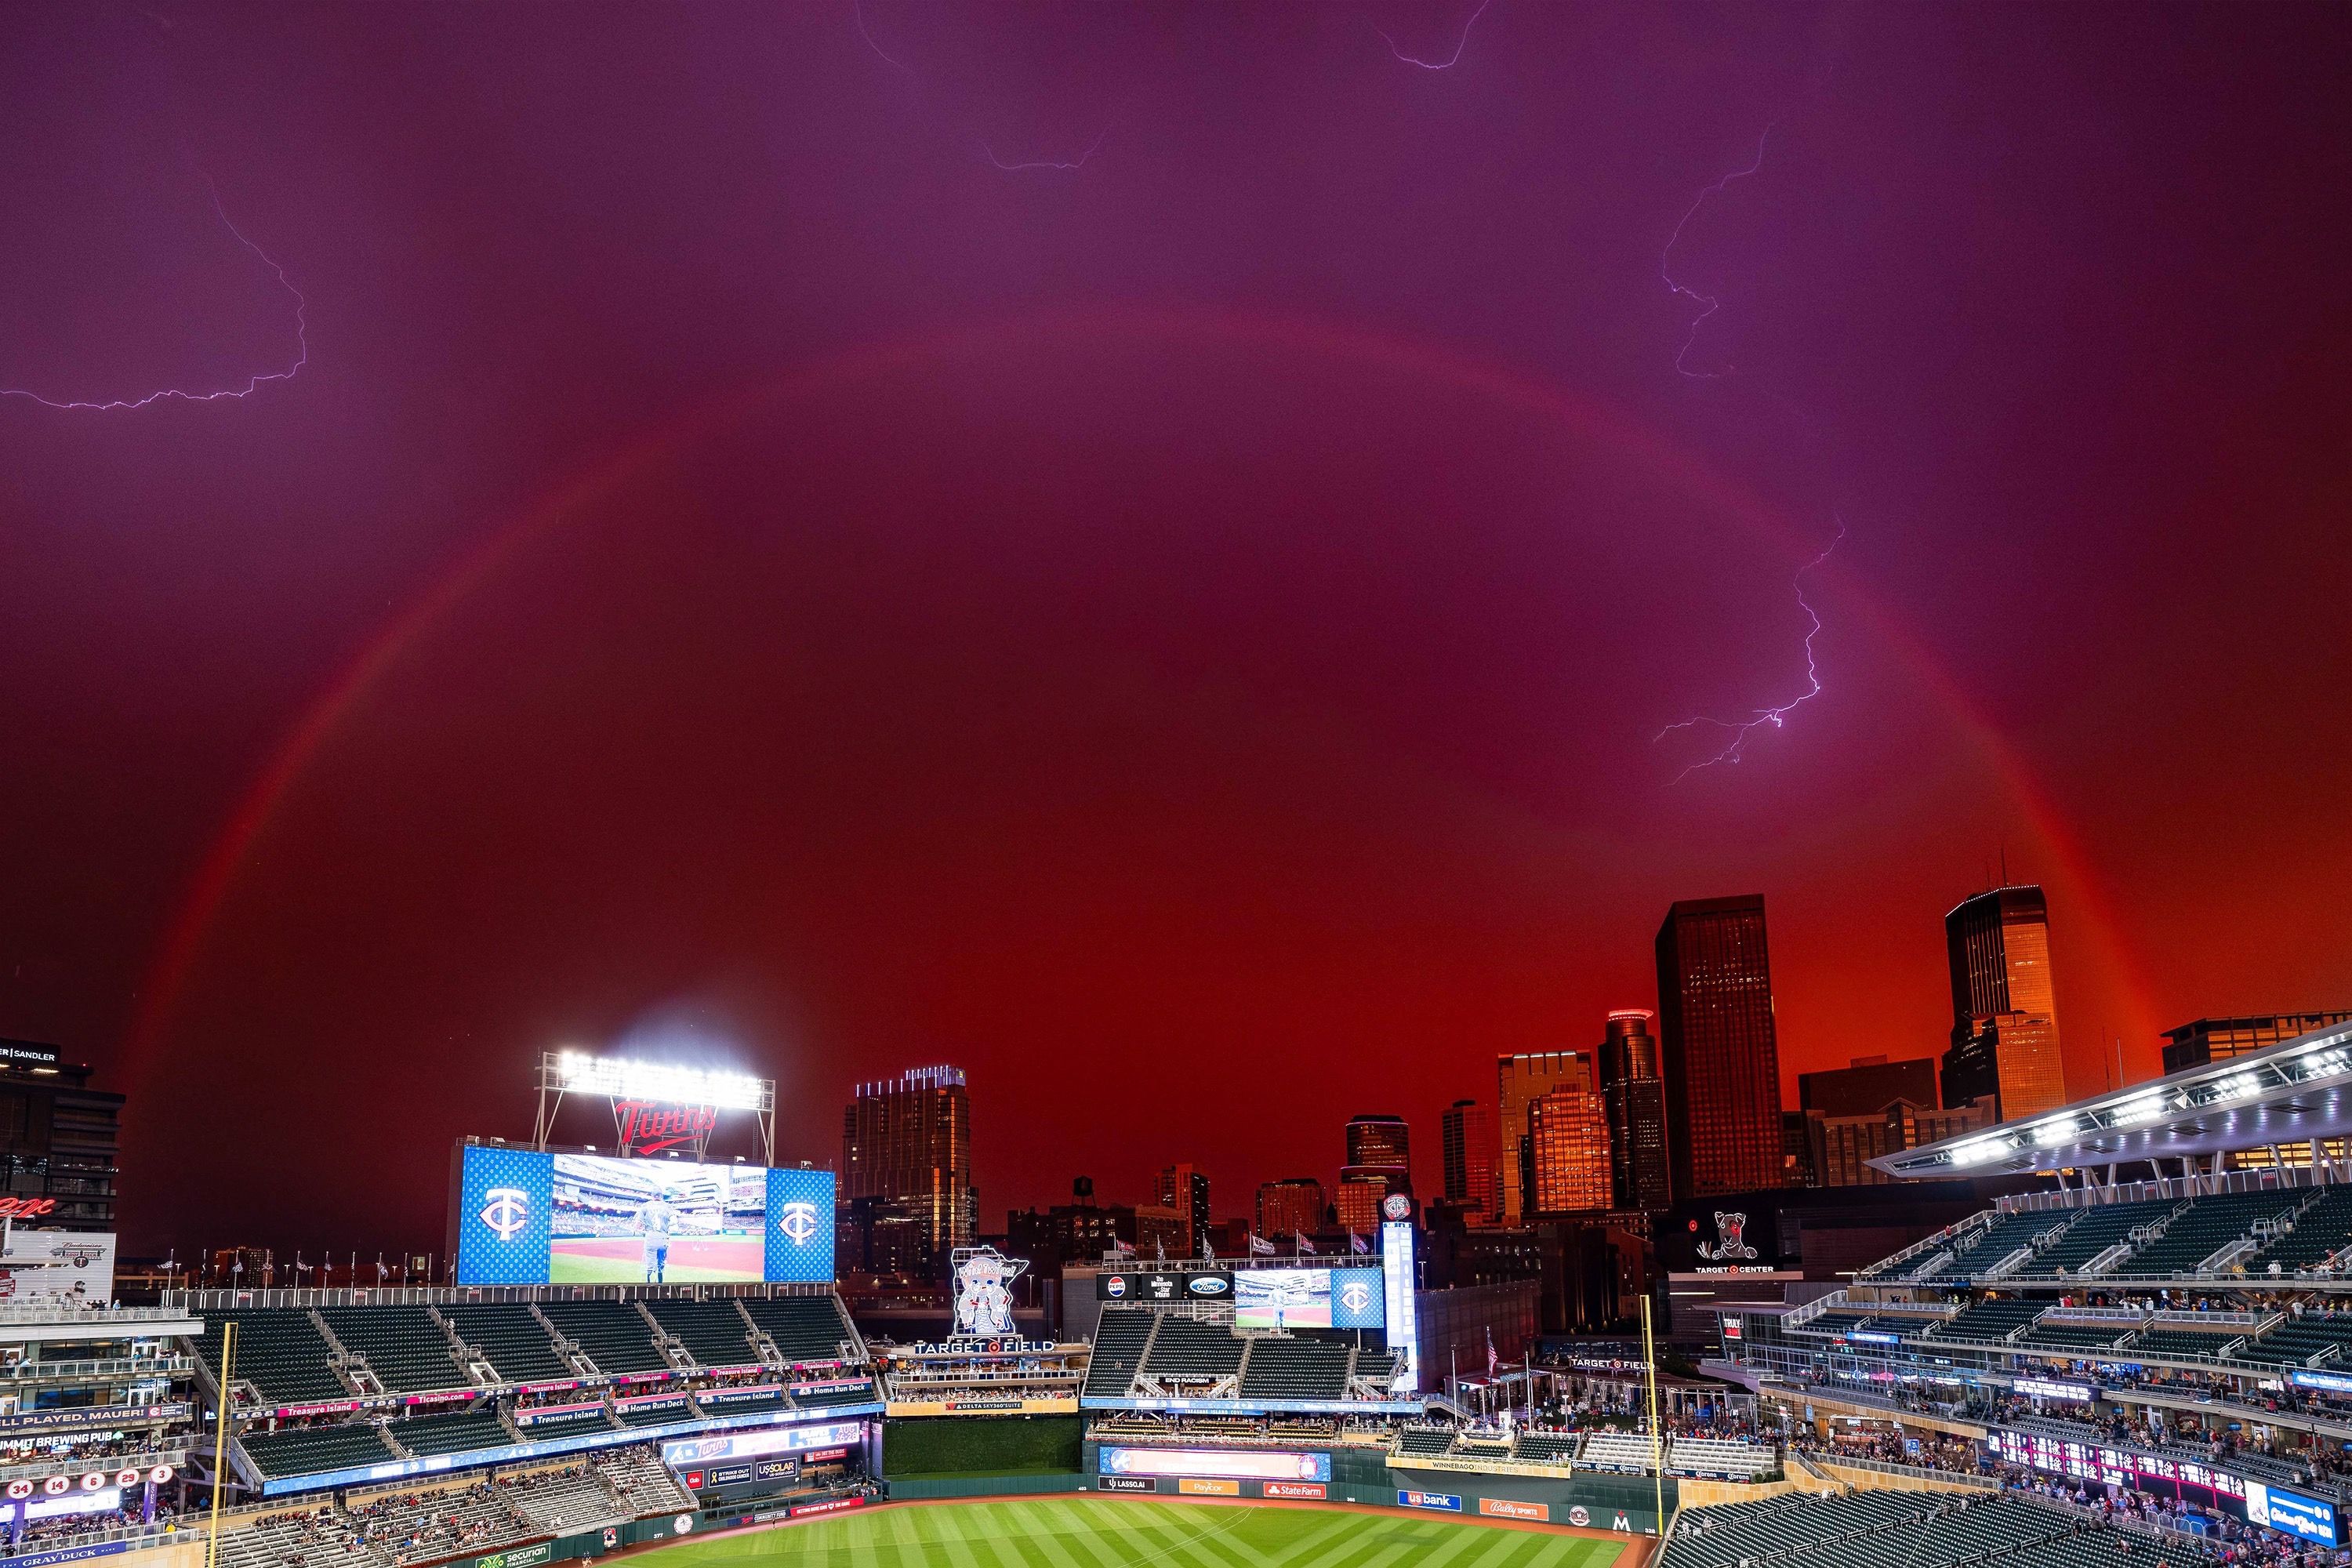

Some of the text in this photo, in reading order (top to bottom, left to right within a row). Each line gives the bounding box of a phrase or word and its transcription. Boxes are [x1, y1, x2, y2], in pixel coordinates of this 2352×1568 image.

[14, 1050, 55, 1062] SANDLER
[615, 1100, 716, 1145] Twins
[1197, 1280, 1219, 1291] Ford
[1724, 1318, 1740, 1328] TRULY
[915, 1341, 1054, 1354] TARGET FIELD
[1571, 1359, 1610, 1368] TARGET
[288, 1403, 352, 1416] Treasure Island
[23, 1414, 85, 1425] PLAYED,
[89, 1409, 144, 1421] MAUER!
[537, 1410, 598, 1425] Treasure Island
[837, 1425, 855, 1434] AUG
[36, 1433, 89, 1447] BREWING
[90, 1431, 113, 1442] PUB
[835, 1432, 858, 1442] 26-28
[695, 1439, 728, 1459] Twins
[1432, 1461, 1519, 1473] WINNEBAGO INDUSTRIES
[122, 1473, 135, 1483] 29
[159, 1470, 165, 1479] 3
[52, 1480, 64, 1490] 14
[90, 1478, 97, 1486] 6
[1194, 1483, 1223, 1492] Paycor
[13, 1484, 28, 1494] 34
[1490, 1501, 1516, 1515] Bally
[754, 1512, 775, 1522] COMMUNITY
[23, 1555, 57, 1566] GRAY
[61, 1548, 96, 1562] DUCK
[506, 1547, 546, 1563] securian
[507, 1558, 535, 1568] FINANCIAL
